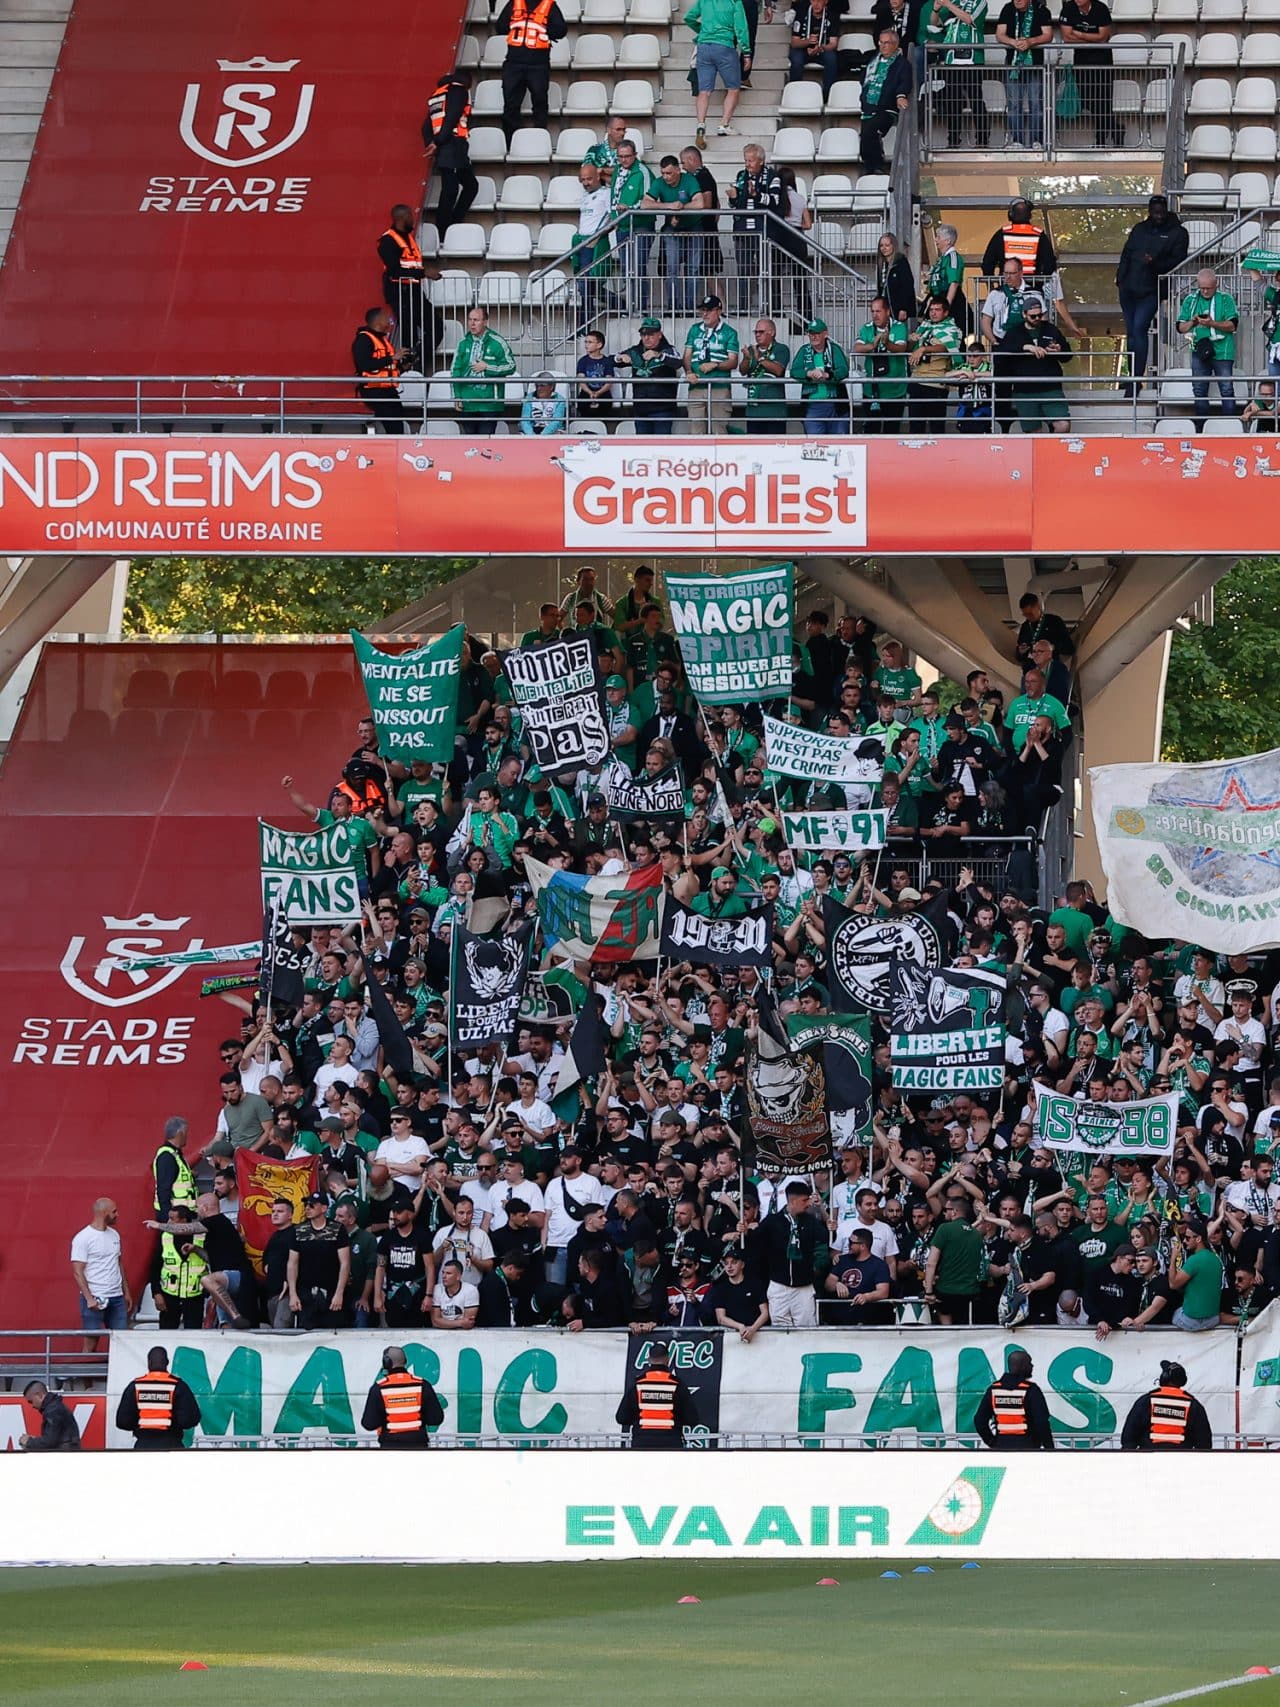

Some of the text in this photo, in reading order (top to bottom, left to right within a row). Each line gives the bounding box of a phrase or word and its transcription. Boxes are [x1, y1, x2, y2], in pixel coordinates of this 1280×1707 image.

[146, 176, 312, 195] STADE
[138, 197, 305, 212] REIMS
[0, 450, 100, 508] ND
[621, 456, 739, 481] La Région
[572, 474, 756, 525] Grand
[46, 517, 323, 541] COMMUNAUTÉ URBAINE
[667, 580, 788, 600] THE ORIGINAL
[669, 593, 789, 635] MAGIC
[678, 628, 791, 662] SPIRIT
[361, 654, 461, 682] MENTALITÉ
[683, 655, 793, 675] CAN NEVER BE
[687, 669, 793, 693] DISSOLVED
[379, 685, 433, 703] NE SE
[373, 704, 450, 726] DISSOUT
[767, 753, 789, 766] UN
[790, 758, 838, 776] CRIME
[813, 745, 843, 763] PAS
[646, 792, 684, 811] NORD
[784, 813, 887, 845] MF 91
[262, 824, 351, 866] MAGIC
[264, 875, 356, 916] FANS
[667, 909, 705, 948] 19
[736, 914, 769, 953] 91
[20, 1016, 196, 1041] STADE
[891, 1026, 1002, 1056] LIBERTE
[12, 1043, 188, 1066] REIMS
[935, 1051, 990, 1065] POUR LES
[892, 1067, 1002, 1088] MAGIC FANS
[1120, 1103, 1171, 1148] 98
[782, 1164, 806, 1174] AVEC
[807, 1158, 833, 1173] NOUS
[800, 1343, 1117, 1448] FANS
[565, 1505, 890, 1546] EVA AIR
